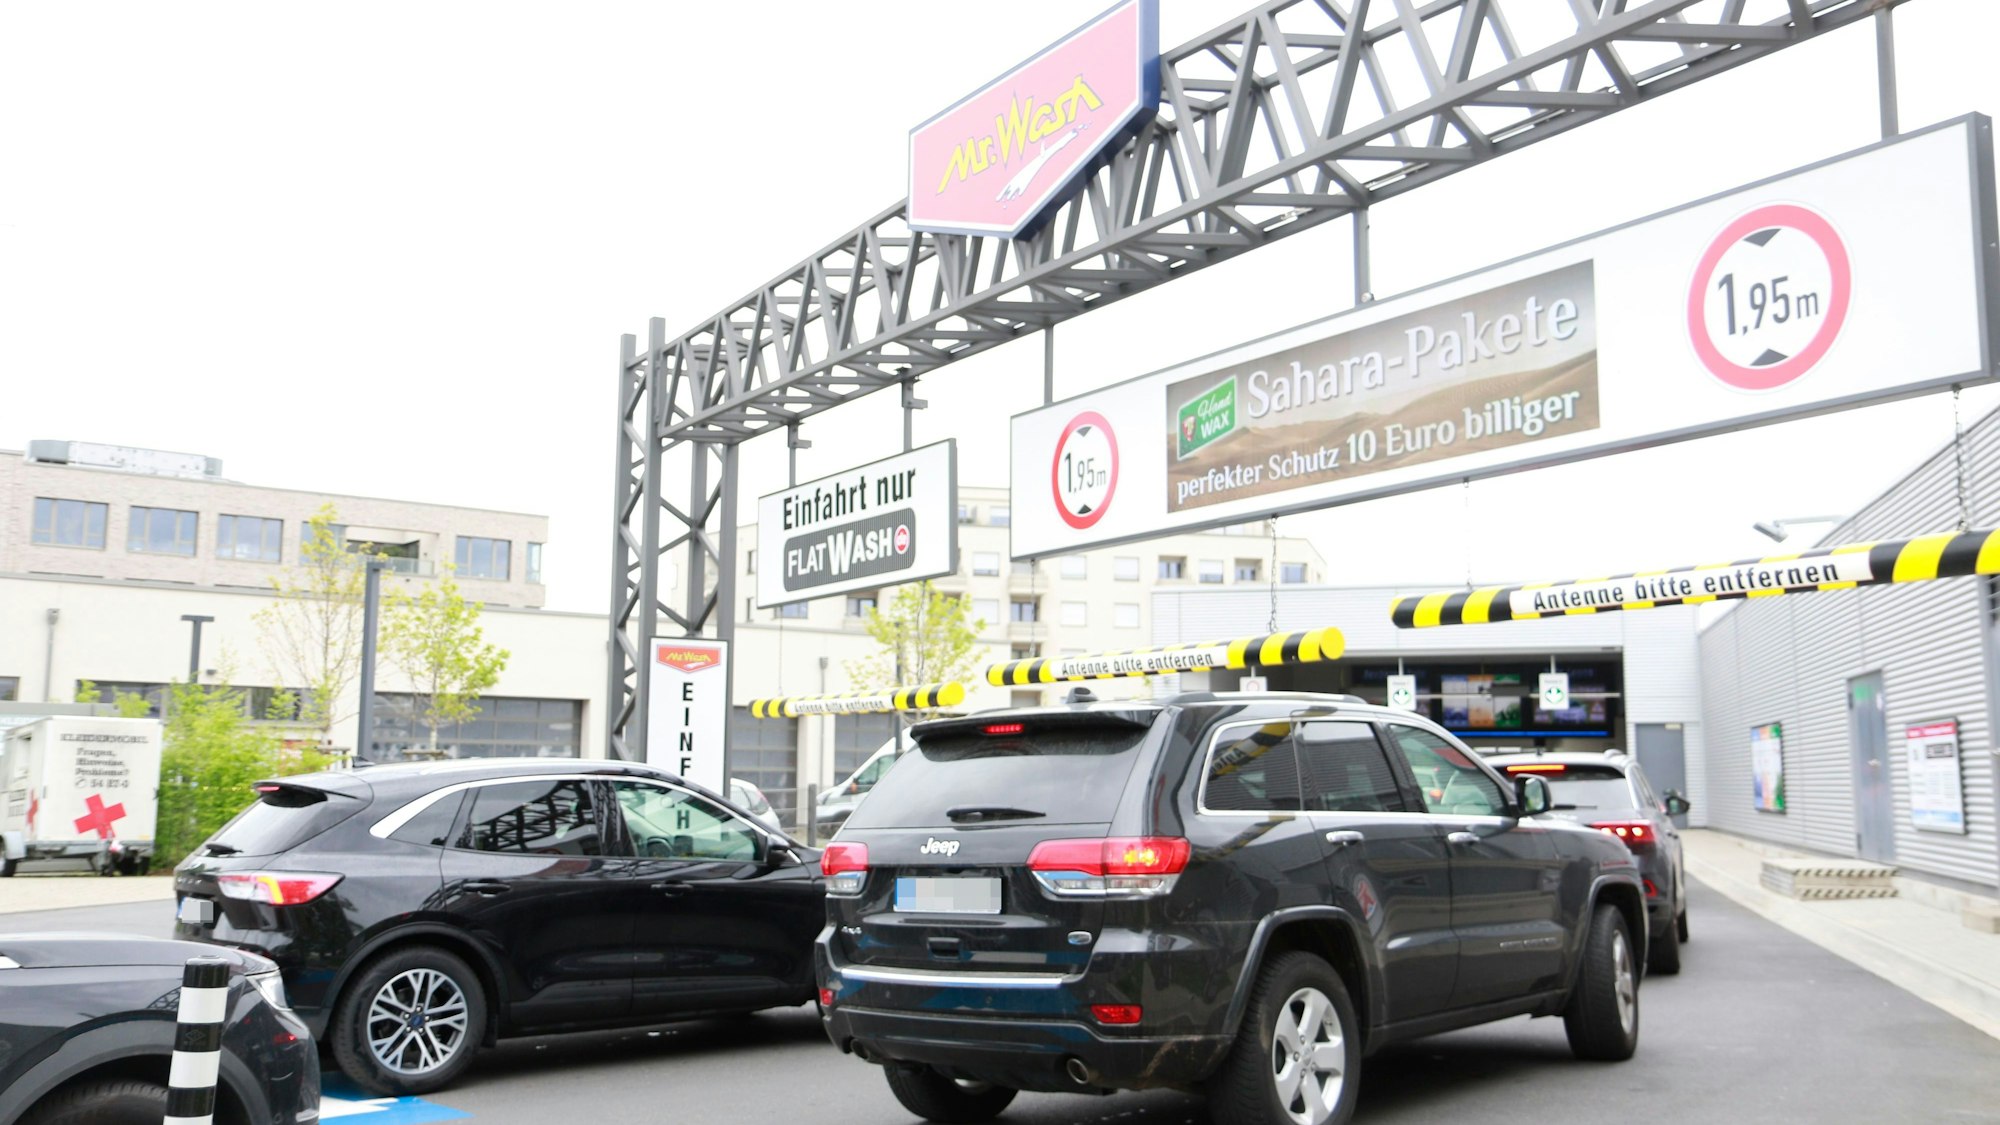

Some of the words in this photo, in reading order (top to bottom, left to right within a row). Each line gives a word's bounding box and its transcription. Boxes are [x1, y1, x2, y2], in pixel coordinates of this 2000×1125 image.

[1246, 296, 1580, 420] Sahara-Pakete
[1200, 410, 1230, 439] WAX
[1176, 461, 1263, 505] perfekter
[1267, 443, 1340, 482] Schutz
[1346, 429, 1377, 465] 10
[1385, 420, 1456, 458] Euro
[1463, 390, 1580, 440] billiger
[783, 475, 867, 531] Einfahrt
[877, 468, 916, 506] nur
[1533, 586, 1625, 612] Antenne
[1634, 578, 1693, 604] bitte
[1704, 561, 1840, 594] entfernen
[1061, 660, 1110, 676] Antenne
[1113, 658, 1144, 673] bitte
[1147, 652, 1214, 670] entfernen
[794, 703, 823, 714] Antenne
[825, 702, 844, 713] bitte
[846, 699, 885, 711] entfernen
[920, 837, 961, 857] Jeep
